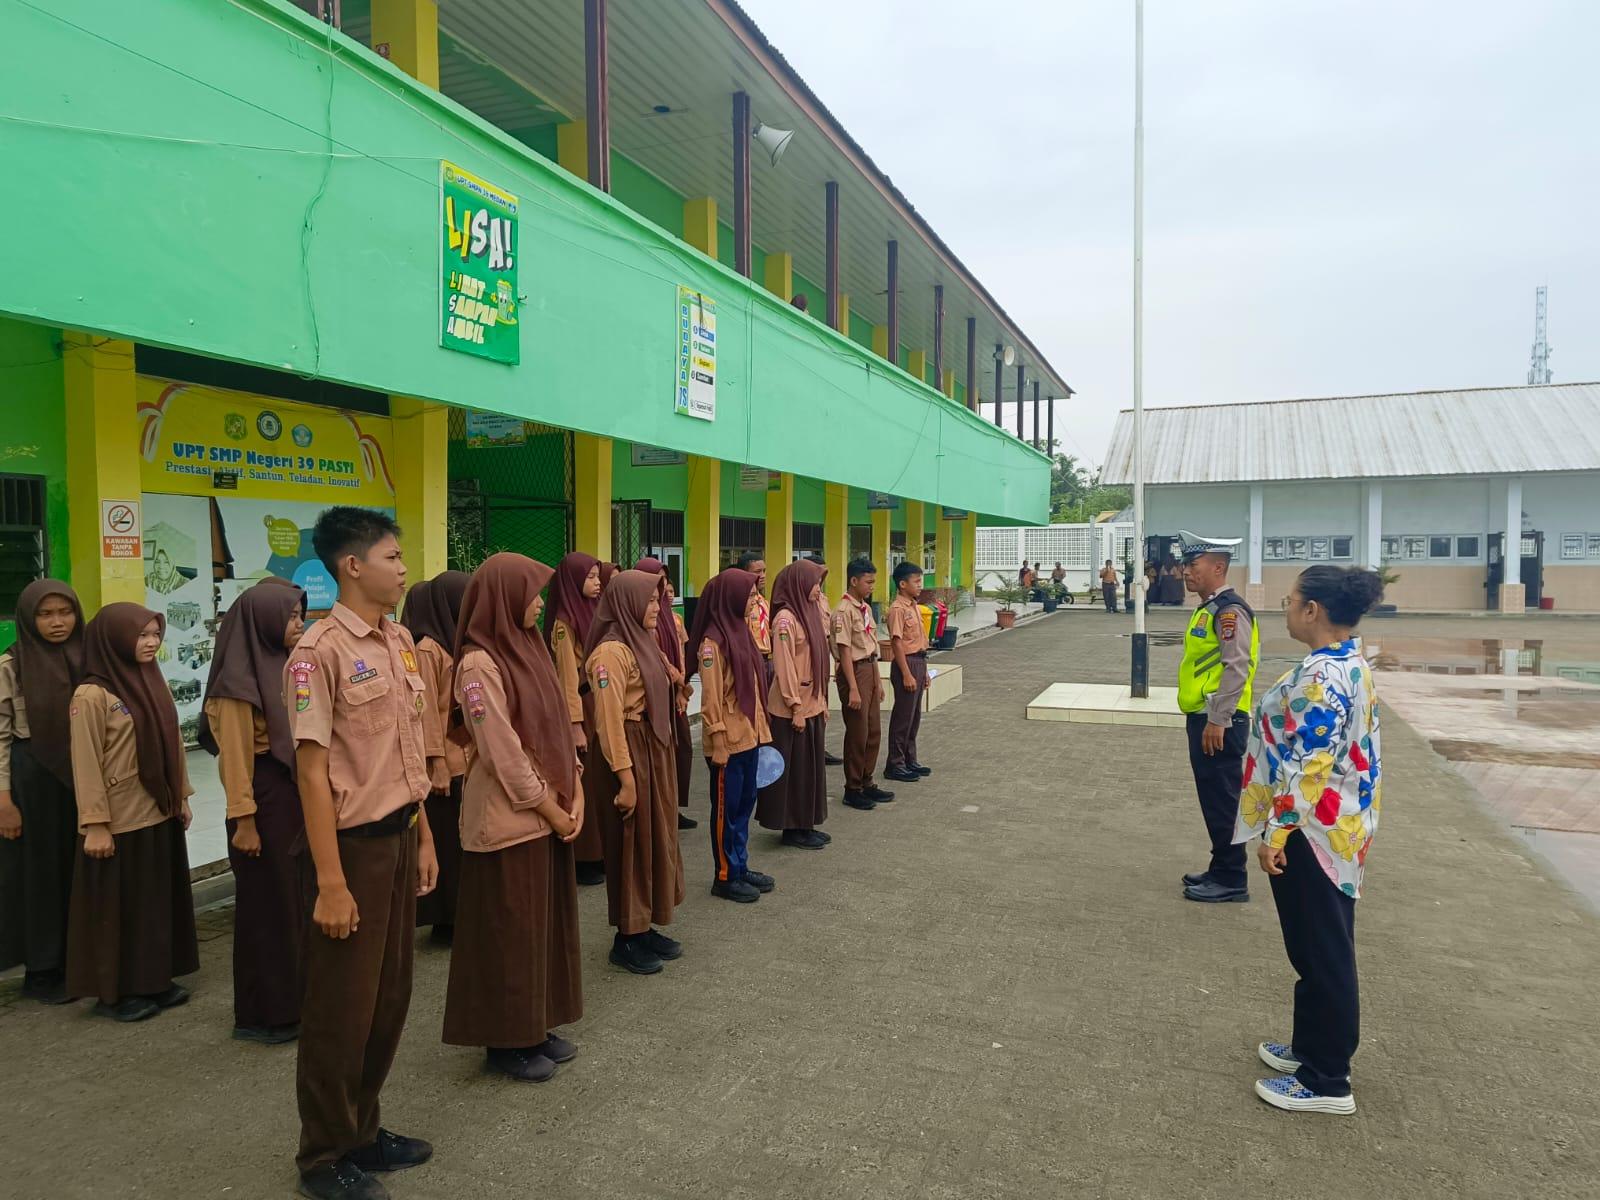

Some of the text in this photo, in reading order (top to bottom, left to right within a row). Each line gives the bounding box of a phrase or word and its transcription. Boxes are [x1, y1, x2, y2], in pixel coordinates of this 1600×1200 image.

[446, 196, 514, 269] LISA!
[173, 442, 354, 474] UPT SMP Negeri 39 PASTI
[328, 475, 360, 488] Inovatif
